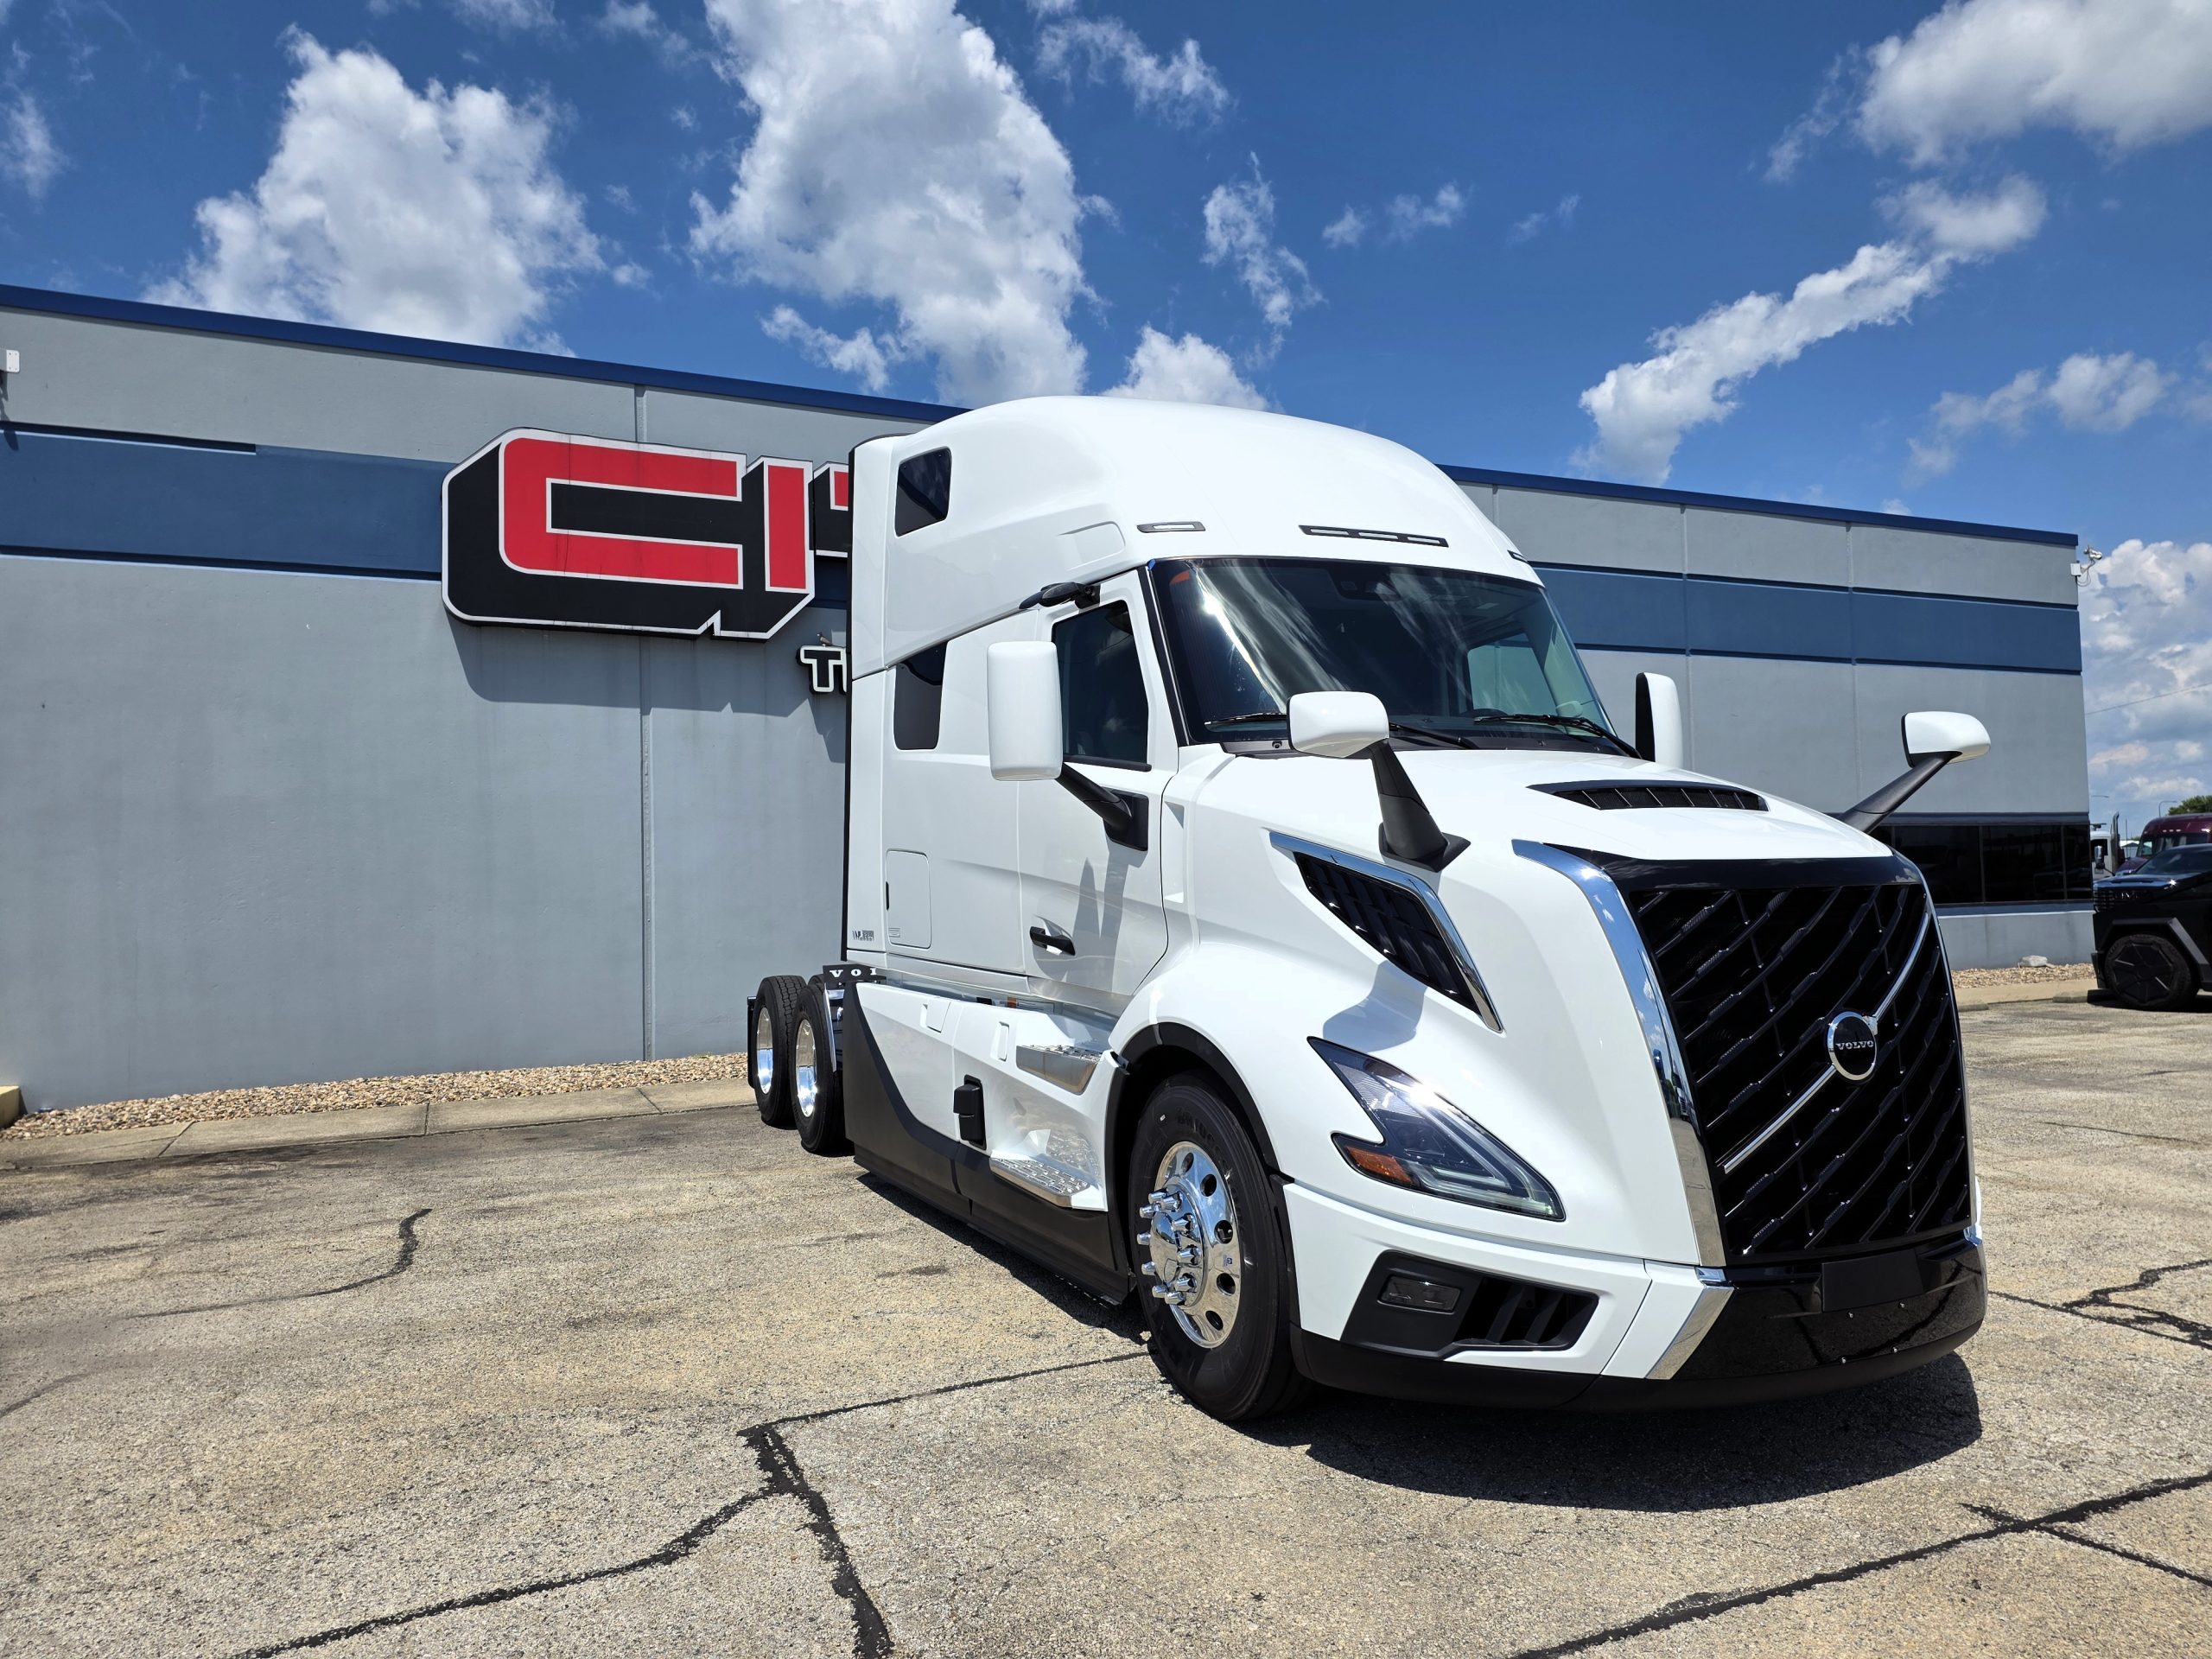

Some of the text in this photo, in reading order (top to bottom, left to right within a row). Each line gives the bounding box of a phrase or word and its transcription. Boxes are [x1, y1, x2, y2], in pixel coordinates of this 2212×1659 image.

[499, 429, 849, 596] CI
[800, 645, 848, 693] T
[1835, 1040, 1874, 1050] VOLVO
